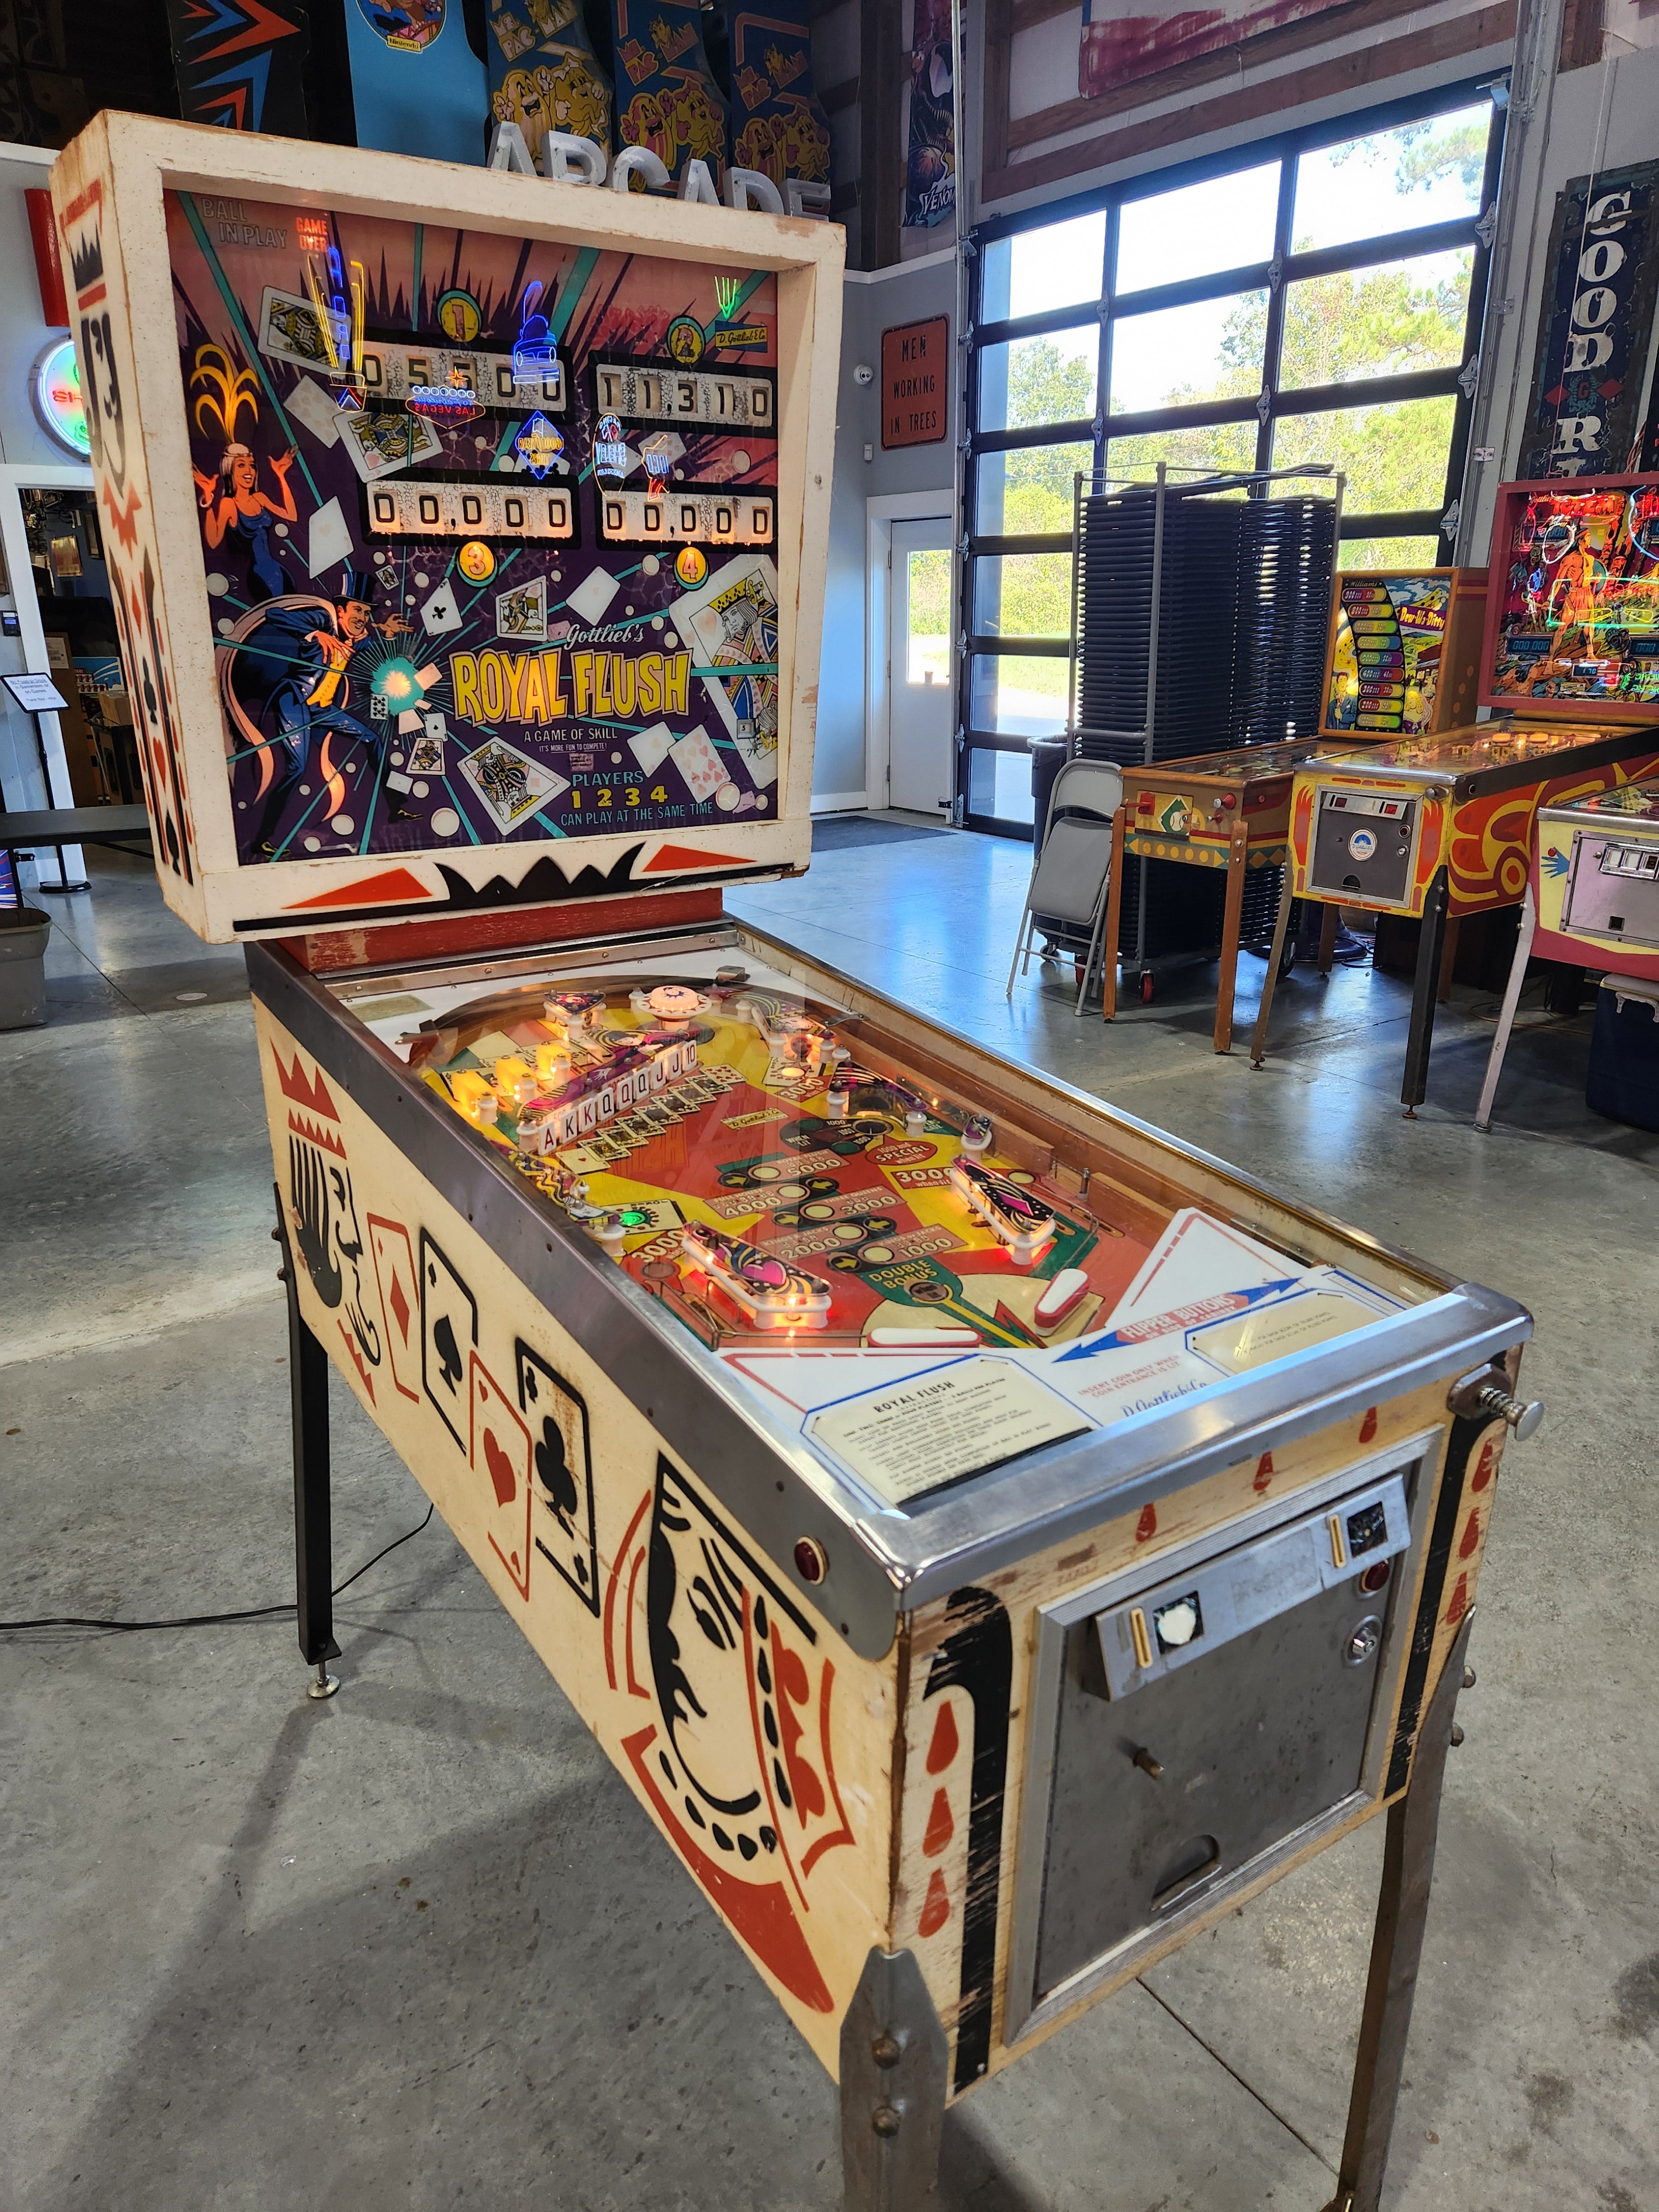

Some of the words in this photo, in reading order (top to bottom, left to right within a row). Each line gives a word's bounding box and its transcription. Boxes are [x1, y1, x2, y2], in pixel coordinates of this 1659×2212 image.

[201, 197, 248, 222] BALL
[220, 222, 239, 244] IN
[242, 225, 288, 249] PLAY
[296, 217, 328, 236] GAME
[299, 234, 328, 252] OVER
[451, 304, 466, 340] 1
[728, 330, 753, 344] Gottlieb
[901, 335, 926, 362] MEN
[893, 375, 935, 399] WORKING
[890, 416, 900, 435] IN
[909, 410, 936, 432] TREES
[467, 545, 485, 575] 3
[682, 551, 698, 580] 4
[563, 623, 645, 650] Gottlieb's
[449, 648, 568, 727] ROYAL
[570, 648, 693, 718] FLUSH
[524, 731, 531, 743] A
[534, 728, 567, 742] GAME
[571, 728, 583, 740] OF
[588, 727, 618, 740] SKILL
[572, 771, 644, 787] PLAYERS
[571, 790, 581, 809] 1
[597, 788, 613, 807] 2
[625, 787, 641, 806] 3
[650, 785, 668, 803] 4
[561, 812, 581, 826] CAN
[586, 811, 612, 825] PLAY
[617, 810, 629, 822] AT
[633, 807, 654, 821] THE
[658, 805, 686, 818] SAME
[689, 802, 713, 816] TIME
[545, 1128, 554, 1150] A
[566, 1115, 575, 1138] K
[584, 1103, 593, 1125] K
[603, 1093, 612, 1114] Q
[622, 1083, 630, 1103] Q
[638, 1074, 647, 1093] Q
[656, 1062, 663, 1082] J
[672, 1052, 679, 1073] J
[686, 1044, 696, 1063] 10
[780, 1078, 825, 1099] 3000
[786, 1135, 810, 1144] WHEN
[875, 1145, 930, 1162] SPECIAL
[787, 1159, 841, 1176] 5000
[725, 1197, 782, 1217] 4000
[841, 1196, 896, 1215] 3000
[632, 1230, 685, 1263] 3000
[780, 1238, 841, 1260] 2000
[898, 1238, 953, 1258] 1000
[868, 1259, 931, 1282] DOUBLE
[883, 1268, 938, 1288] BONUS
[1120, 1313, 1177, 1338] FLIPPER
[1173, 1295, 1236, 1320] BUTTONS
[1078, 1381, 1110, 1395] INSERT
[1111, 1373, 1132, 1383] COIN
[1133, 1365, 1154, 1375] ONLY
[1154, 1355, 1181, 1366] WHEN
[1091, 1386, 1114, 1397] COIN
[1114, 1371, 1158, 1389] ENTRANCE
[873, 1395, 915, 1413] ROYAL
[917, 1381, 956, 1397] FLUSH
